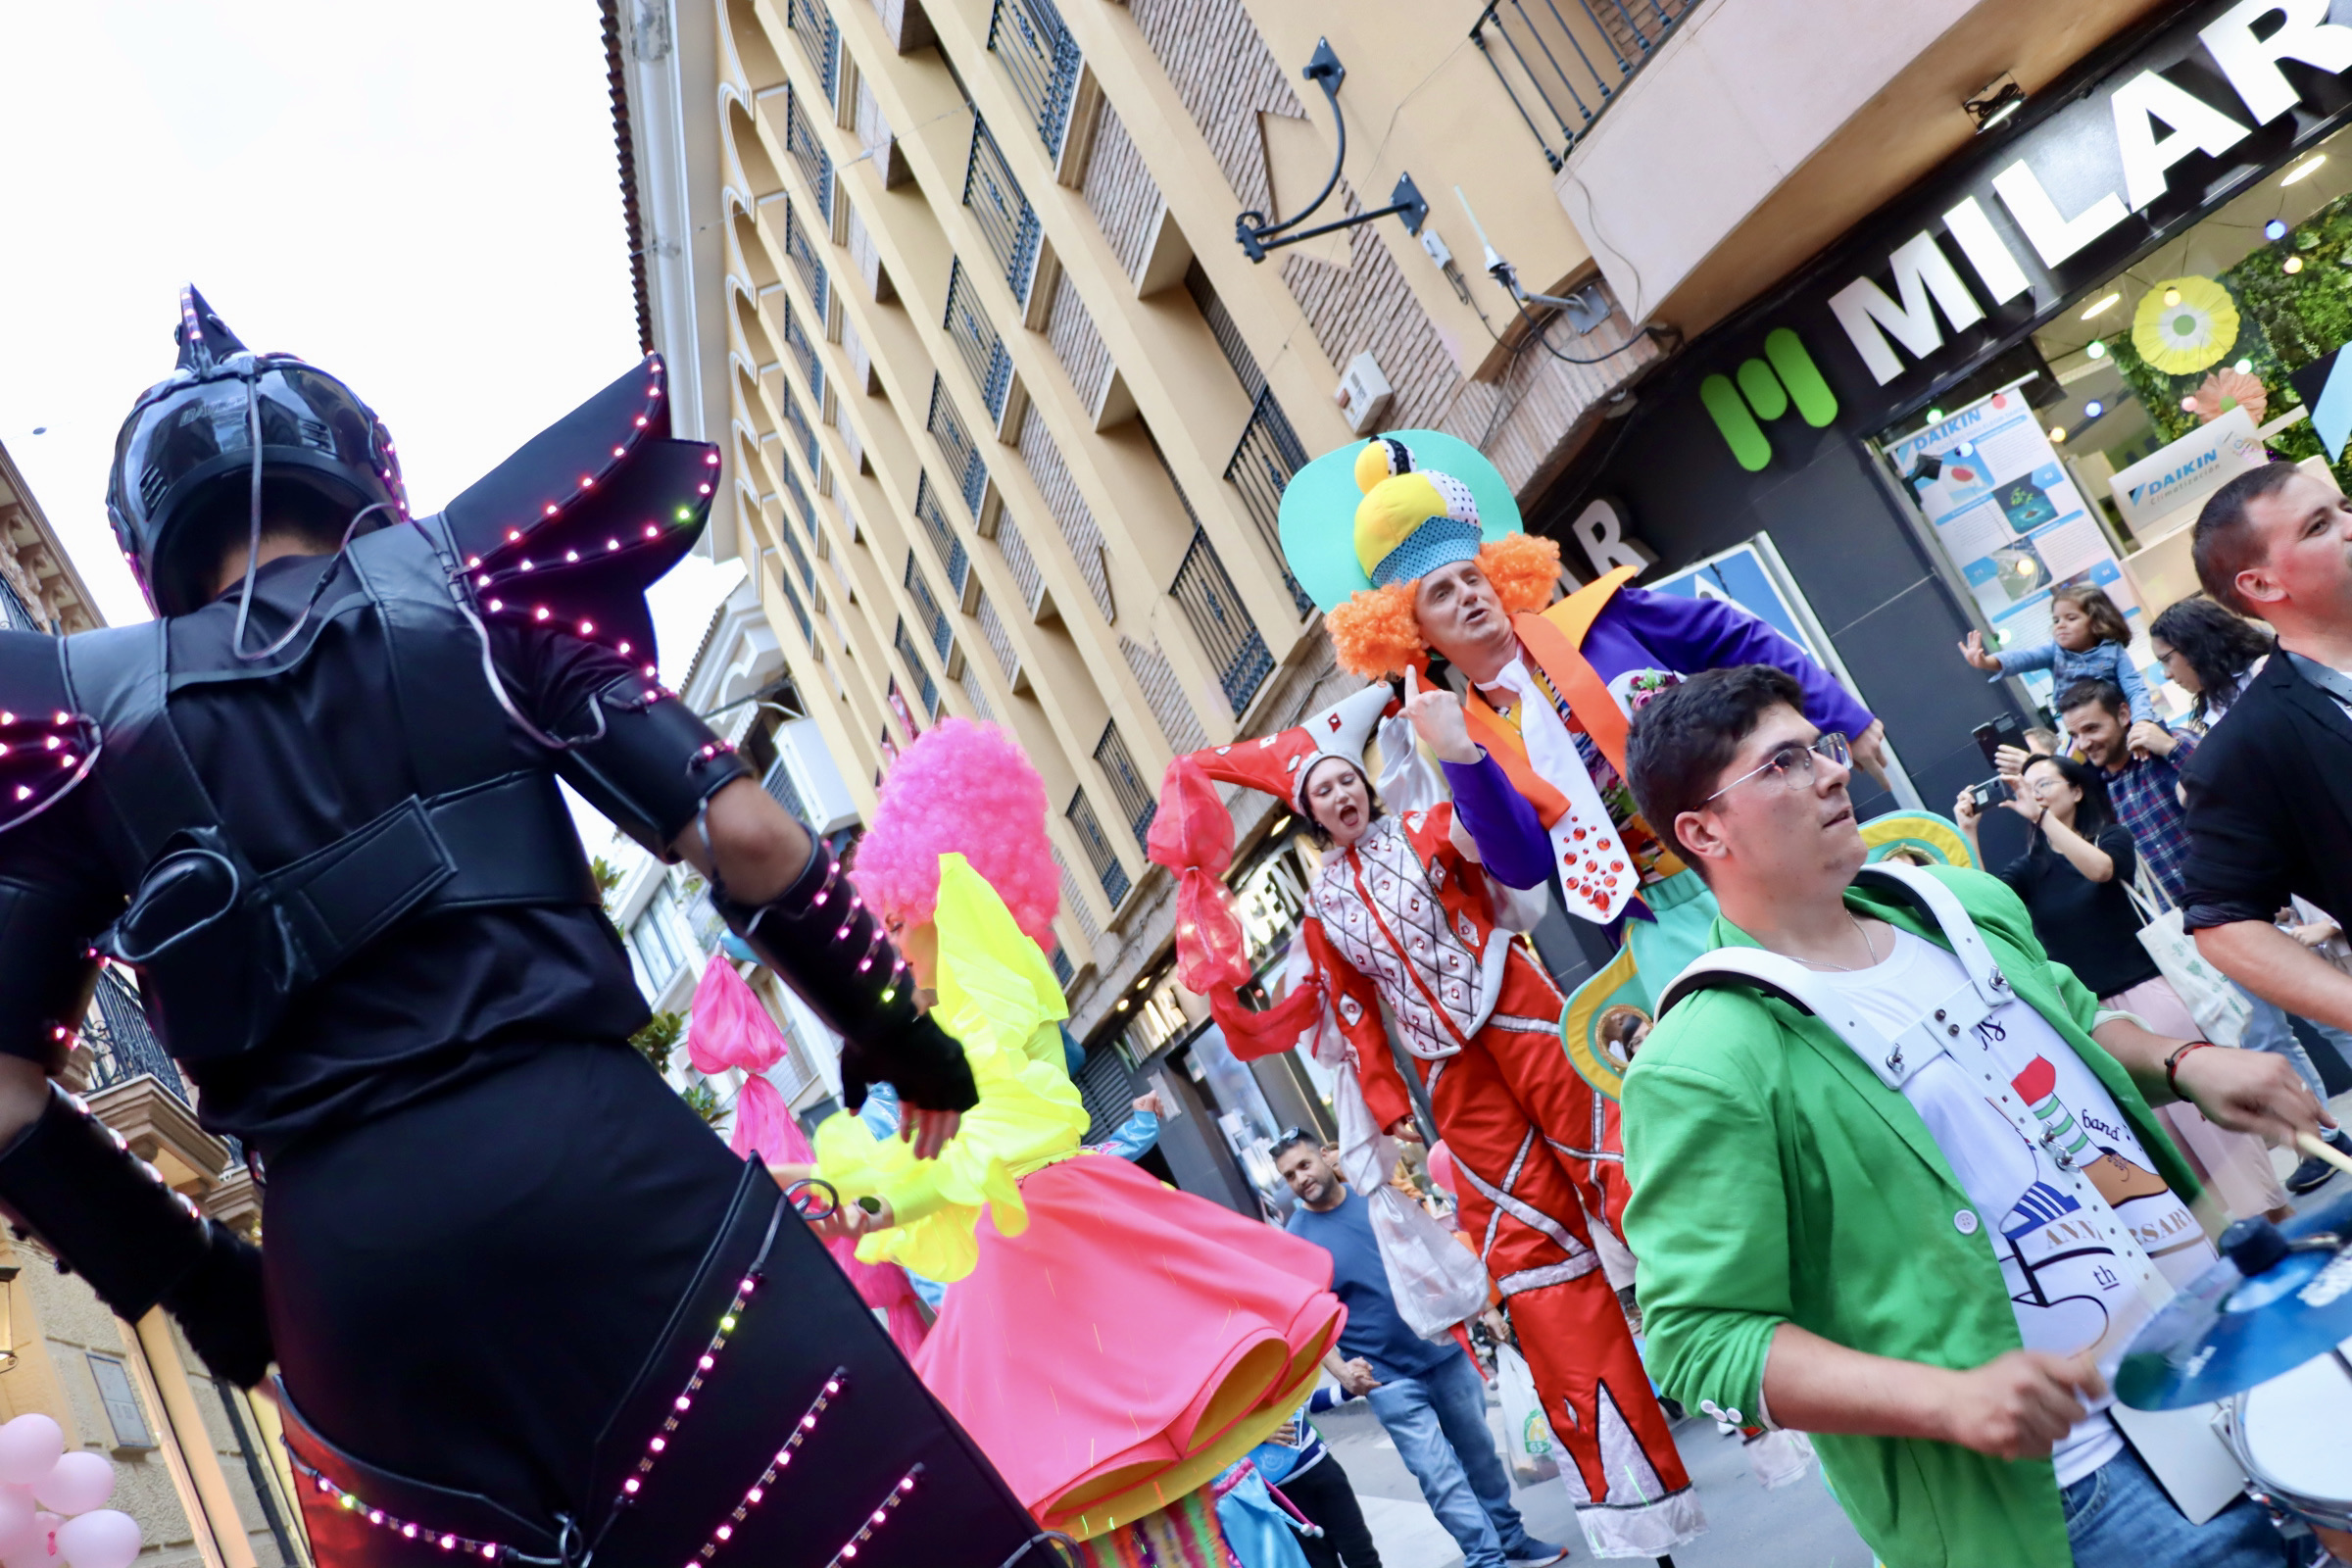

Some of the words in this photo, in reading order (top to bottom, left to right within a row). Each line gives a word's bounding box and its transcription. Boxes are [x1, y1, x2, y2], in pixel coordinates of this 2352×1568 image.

[1828, 0, 2352, 386] MILAR
[1914, 408, 1982, 451] DAIKIN
[2148, 448, 2218, 496] DAIKIN
[2150, 463, 2221, 506] Climatización
[2082, 1108, 2121, 1142] band
